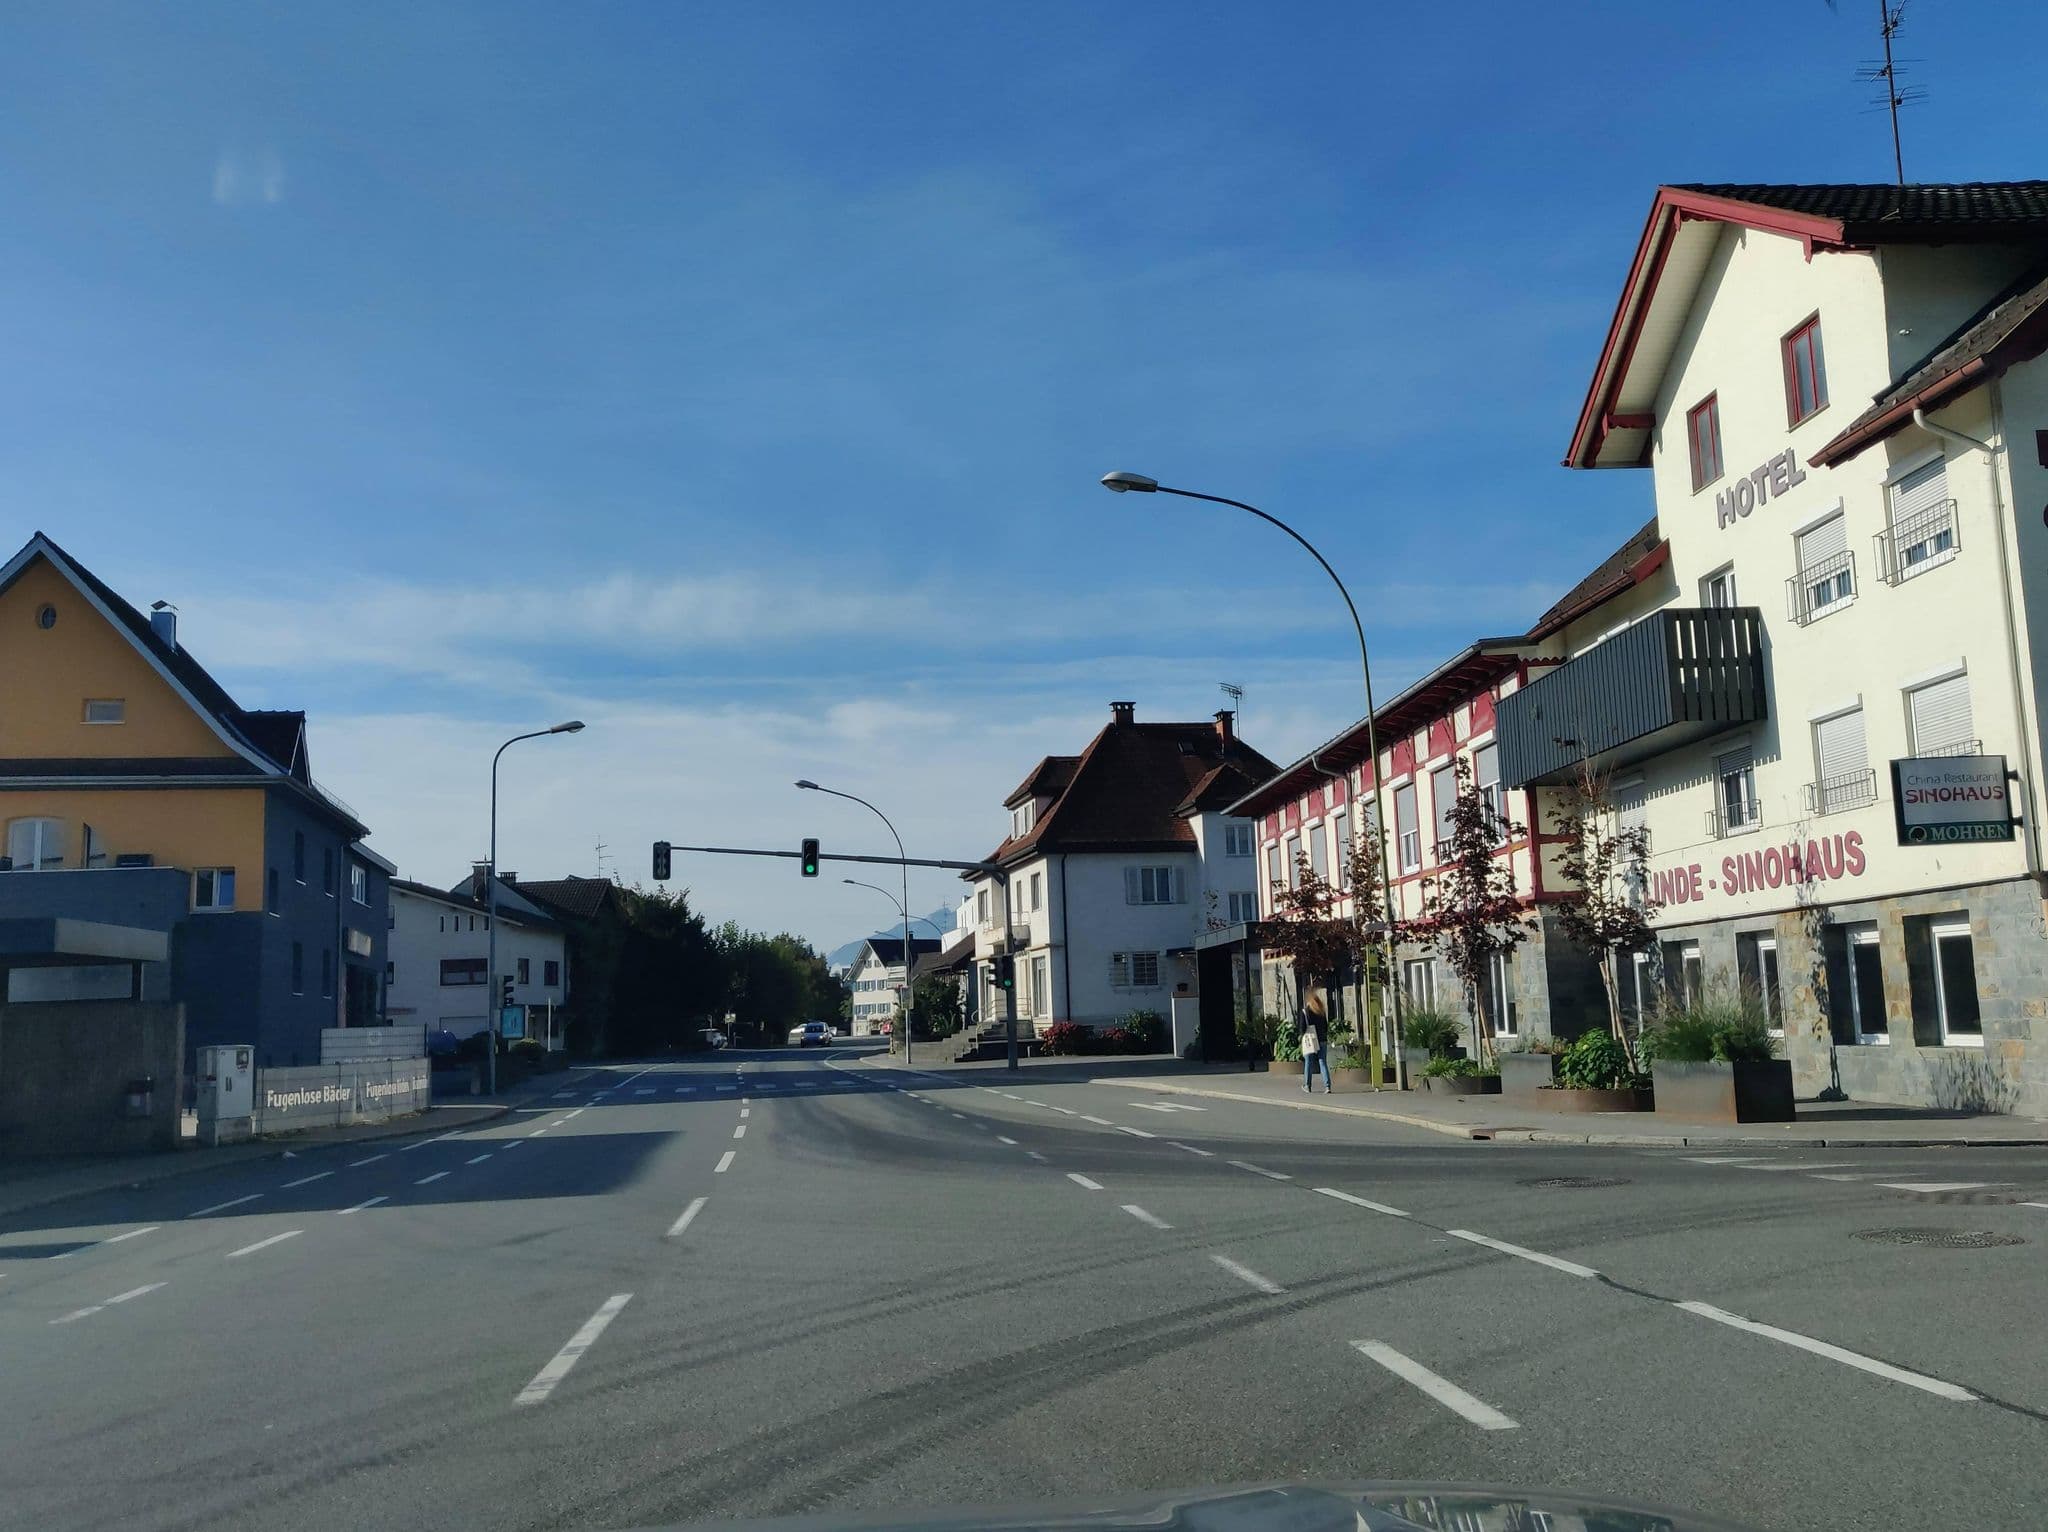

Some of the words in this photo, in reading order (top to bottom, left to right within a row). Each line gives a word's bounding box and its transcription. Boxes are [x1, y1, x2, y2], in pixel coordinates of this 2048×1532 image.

[1716, 447, 1806, 530] HOTEL
[1907, 774, 1941, 786] China
[1944, 772, 1999, 784] Restaurant
[1905, 786, 2004, 804] SINOHAUS
[1930, 825, 2008, 841] MOHREN
[1722, 830, 1866, 897] SINOHAUS
[267, 1087, 322, 1112] Fugenlose
[323, 1084, 350, 1103] Bäder
